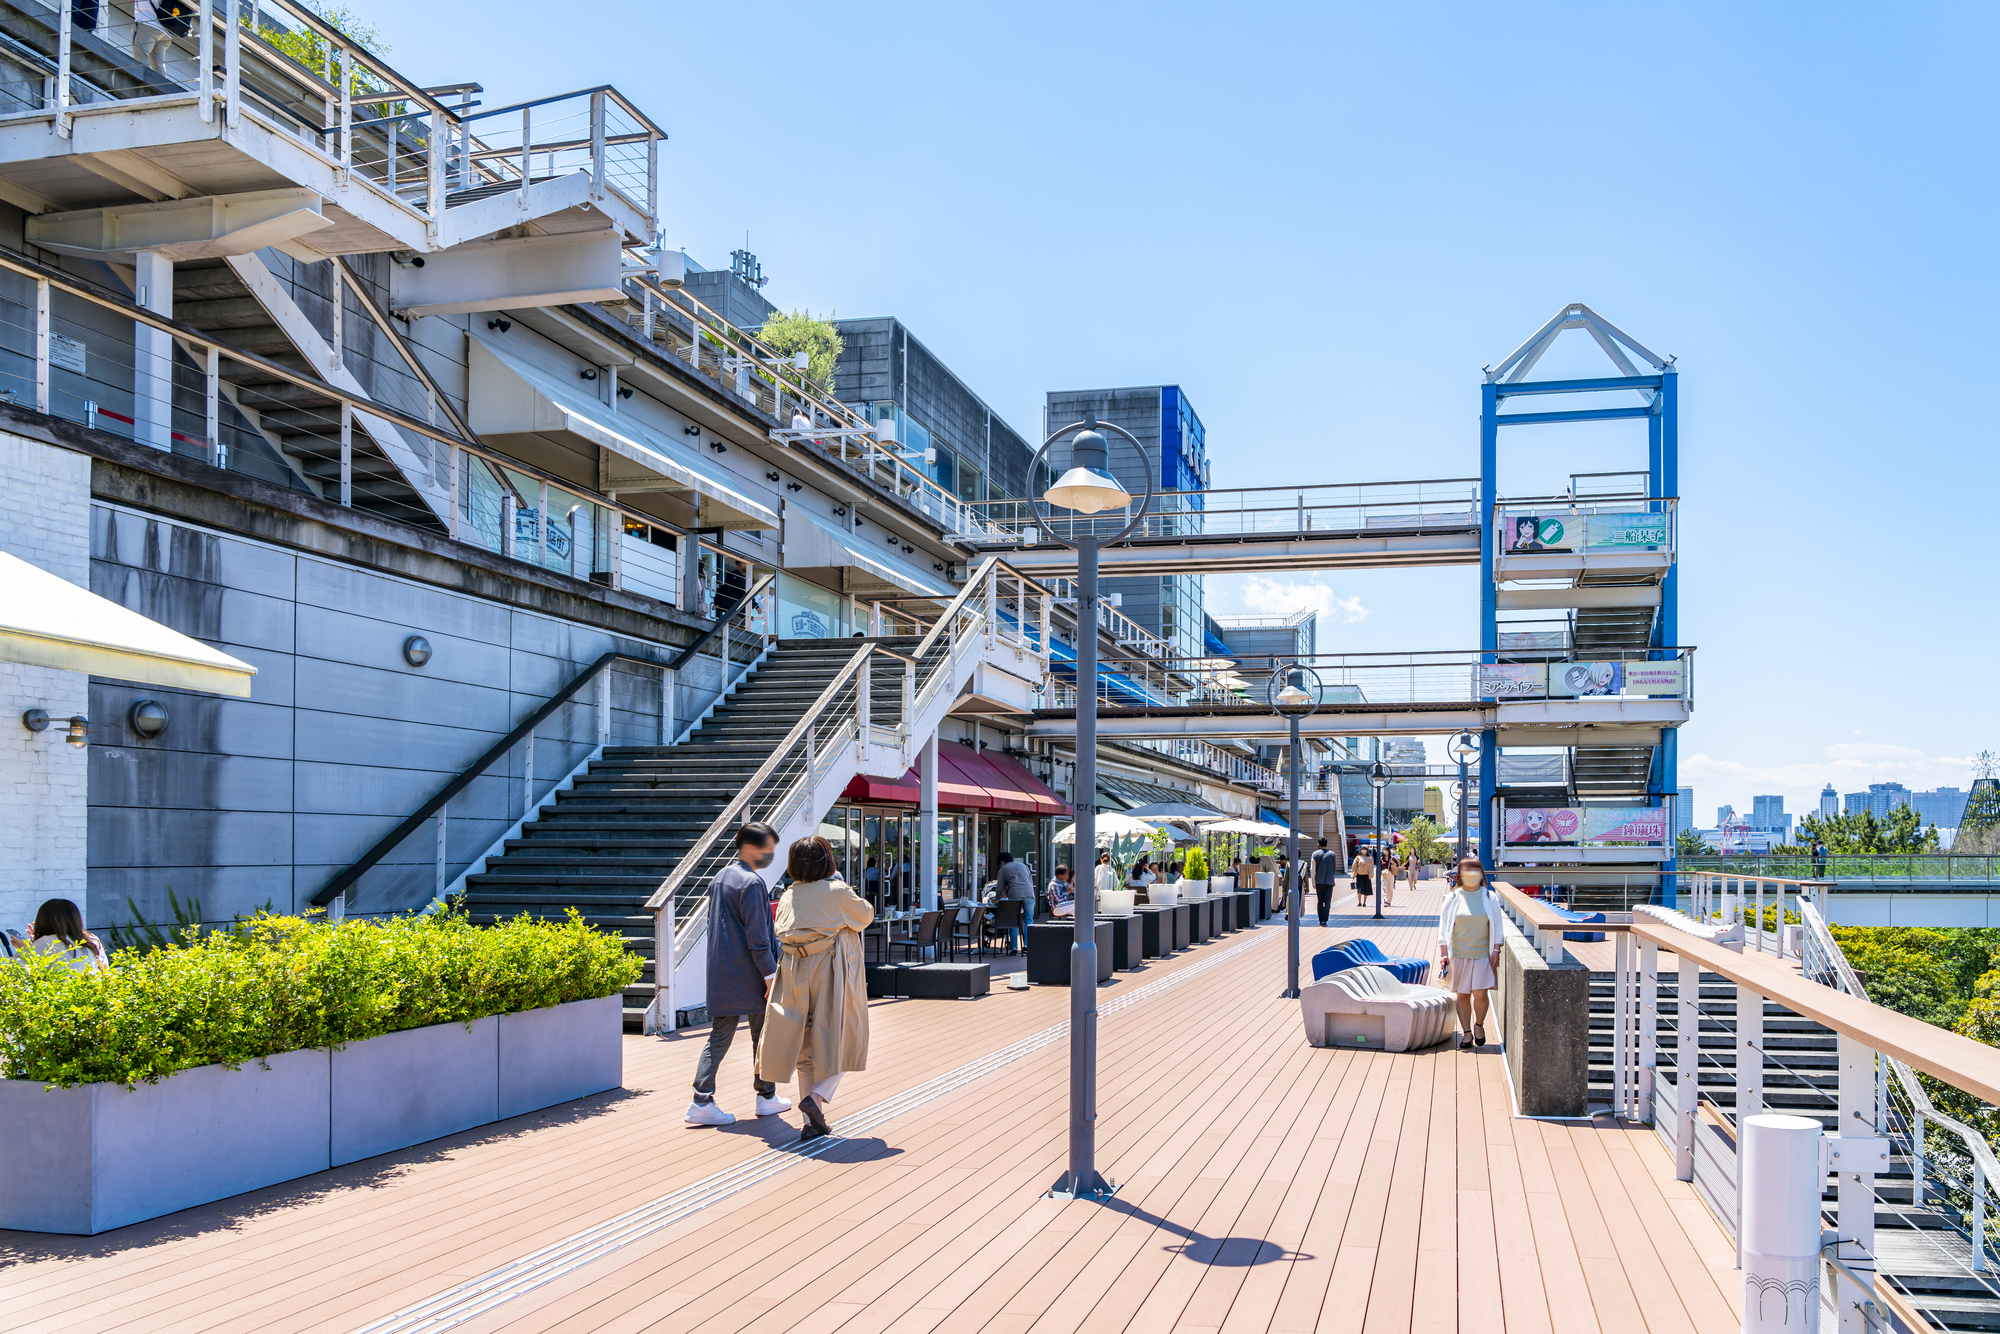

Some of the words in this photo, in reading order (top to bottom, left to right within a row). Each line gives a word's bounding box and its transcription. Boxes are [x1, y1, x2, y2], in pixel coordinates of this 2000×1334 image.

[1613, 529, 1663, 543] 三船栞子
[1588, 811, 1624, 821] ZHONG
[1622, 823, 1662, 837] 鐘嵐珠
